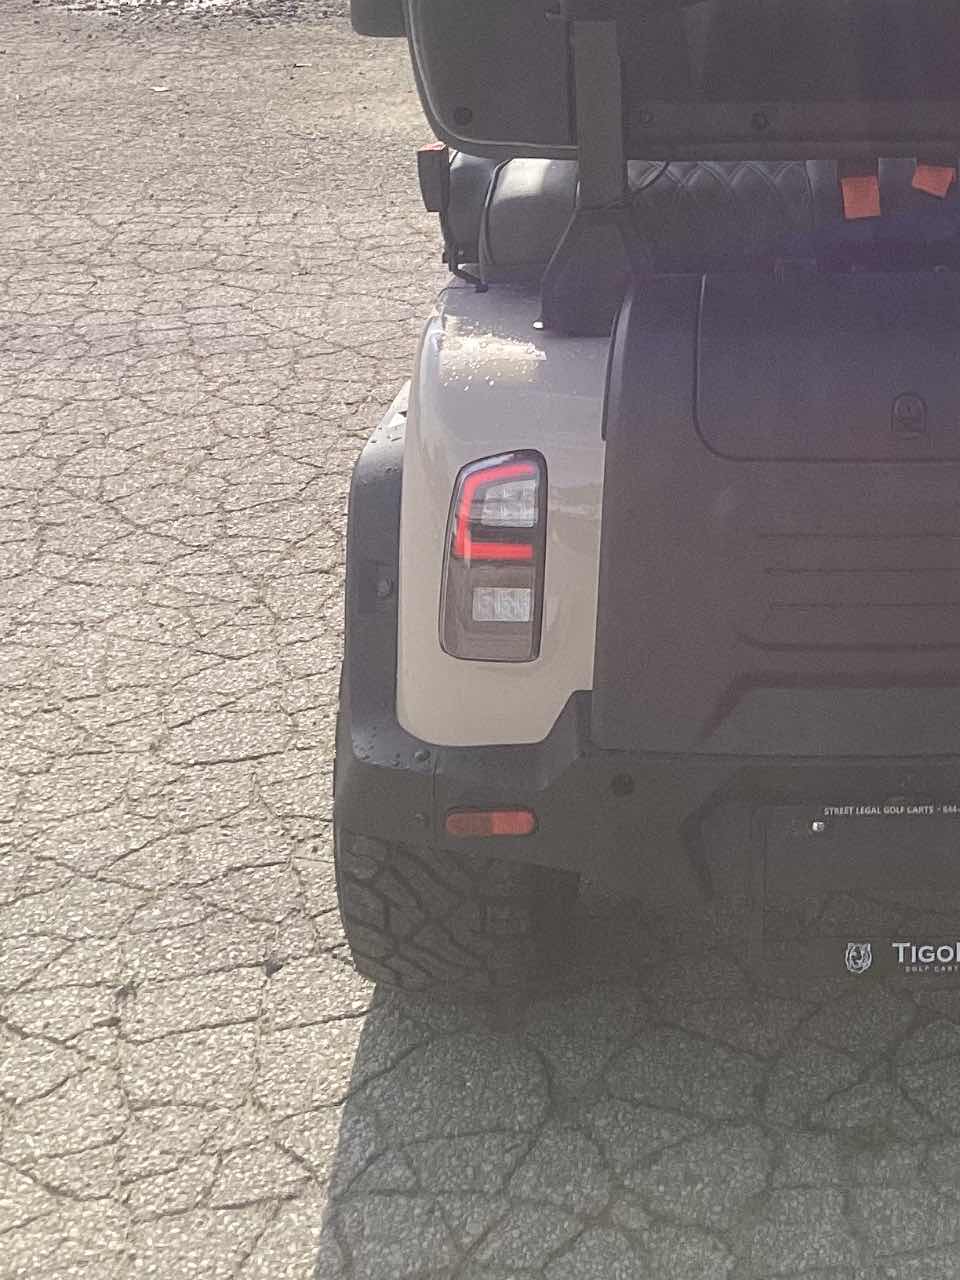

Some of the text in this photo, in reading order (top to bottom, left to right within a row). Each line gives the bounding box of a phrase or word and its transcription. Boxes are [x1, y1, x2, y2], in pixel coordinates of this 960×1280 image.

[824, 807, 853, 816] STREET
[856, 806, 881, 815] LEGAL
[883, 806, 904, 815] GOLF
[906, 805, 934, 815] CARTS
